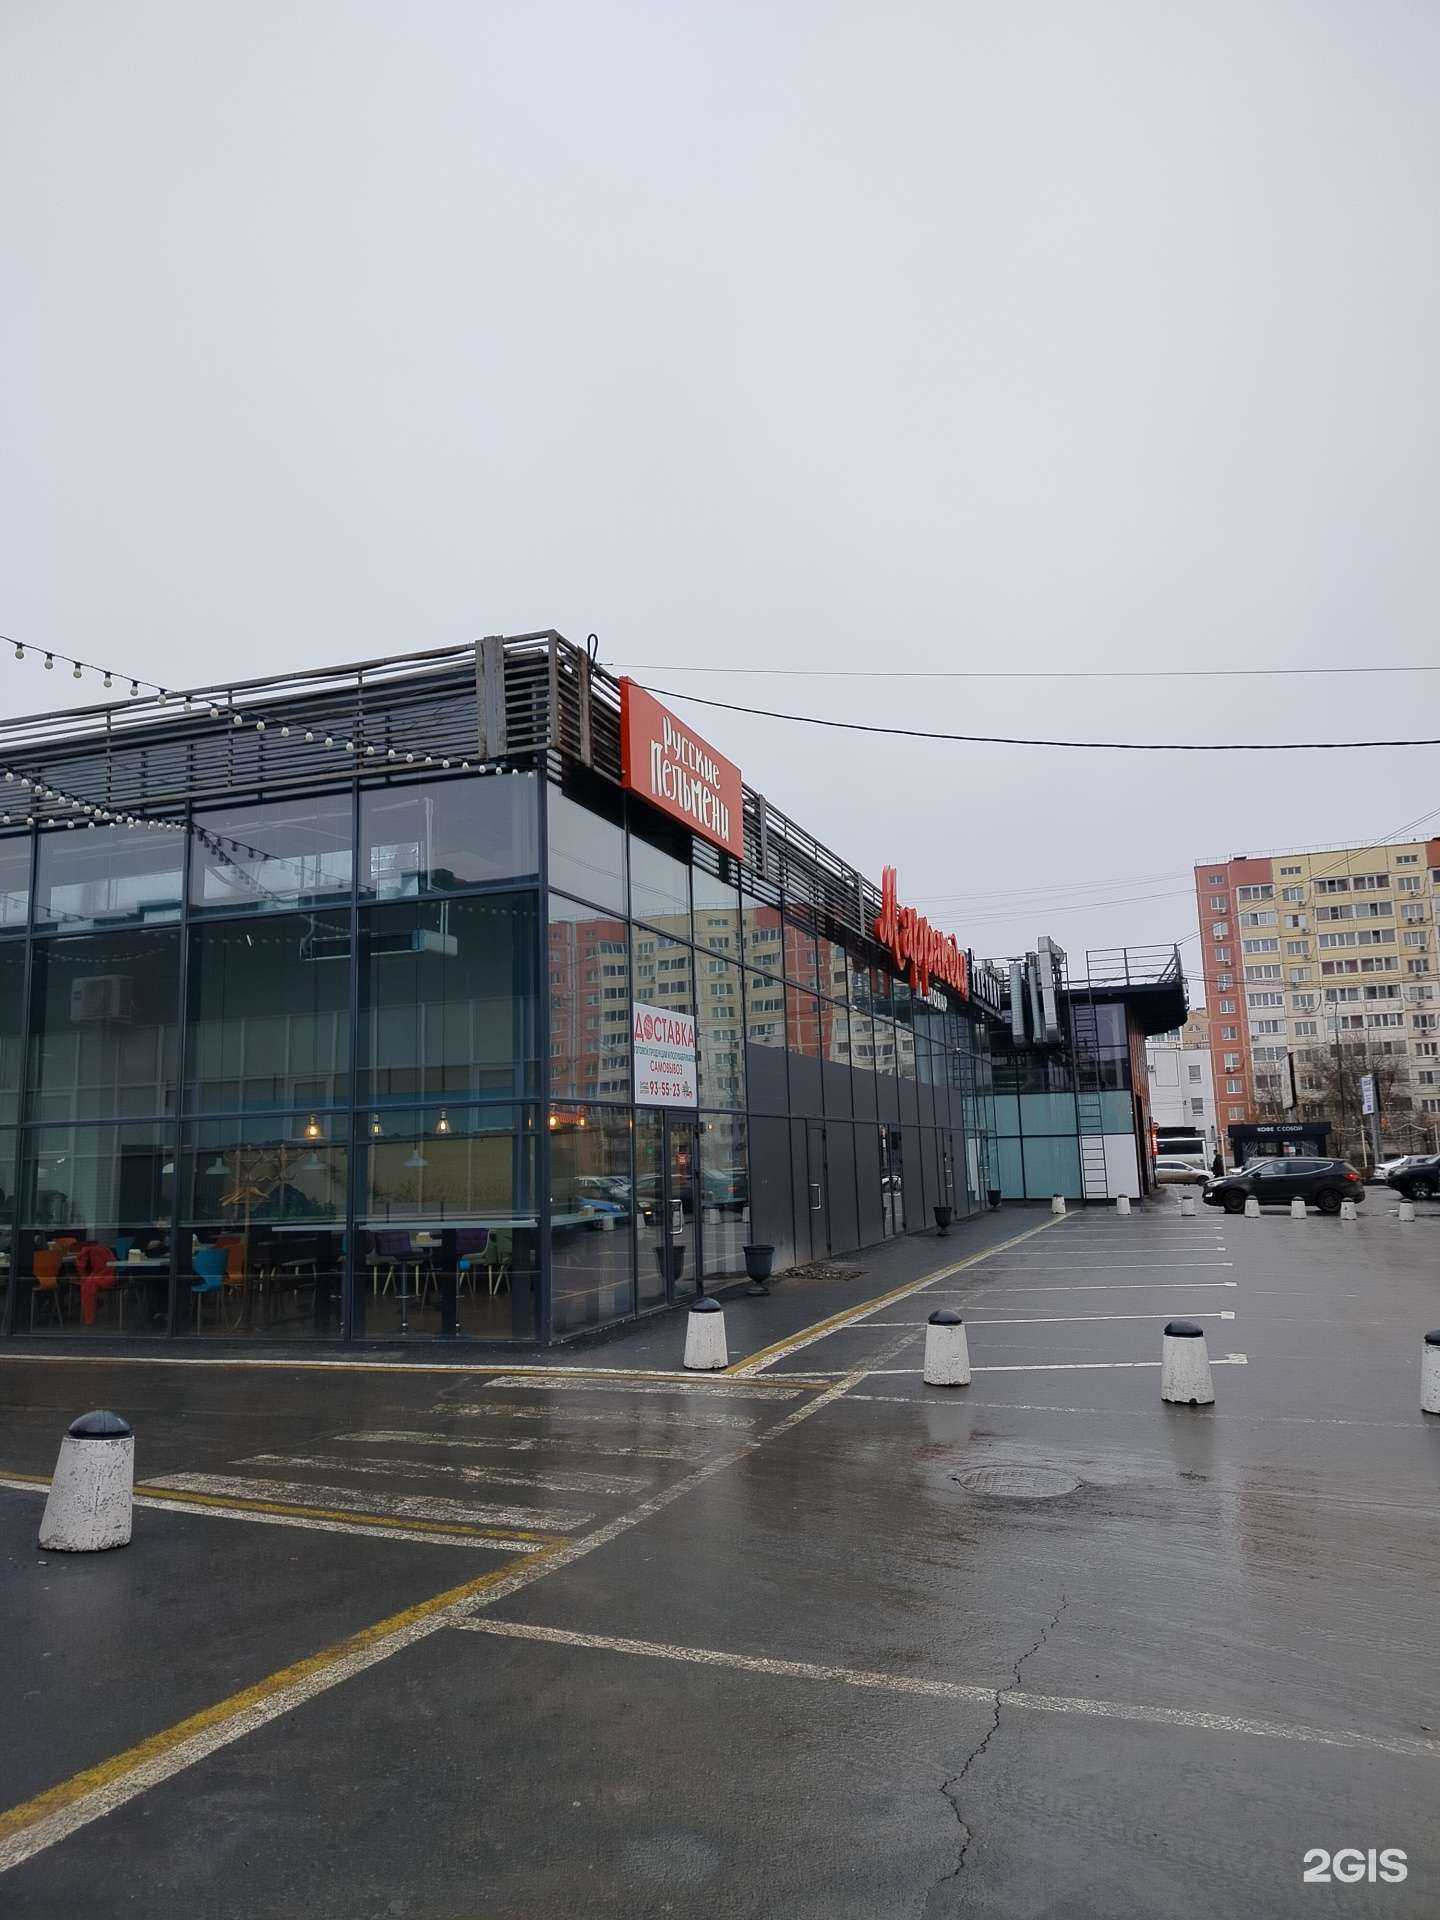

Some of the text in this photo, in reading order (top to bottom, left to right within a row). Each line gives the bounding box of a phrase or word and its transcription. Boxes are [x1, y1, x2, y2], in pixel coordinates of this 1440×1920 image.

[662, 715, 721, 789] Русские
[650, 739, 729, 842] Пельмени
[634, 1012, 695, 1048] ДОСТАВКА
